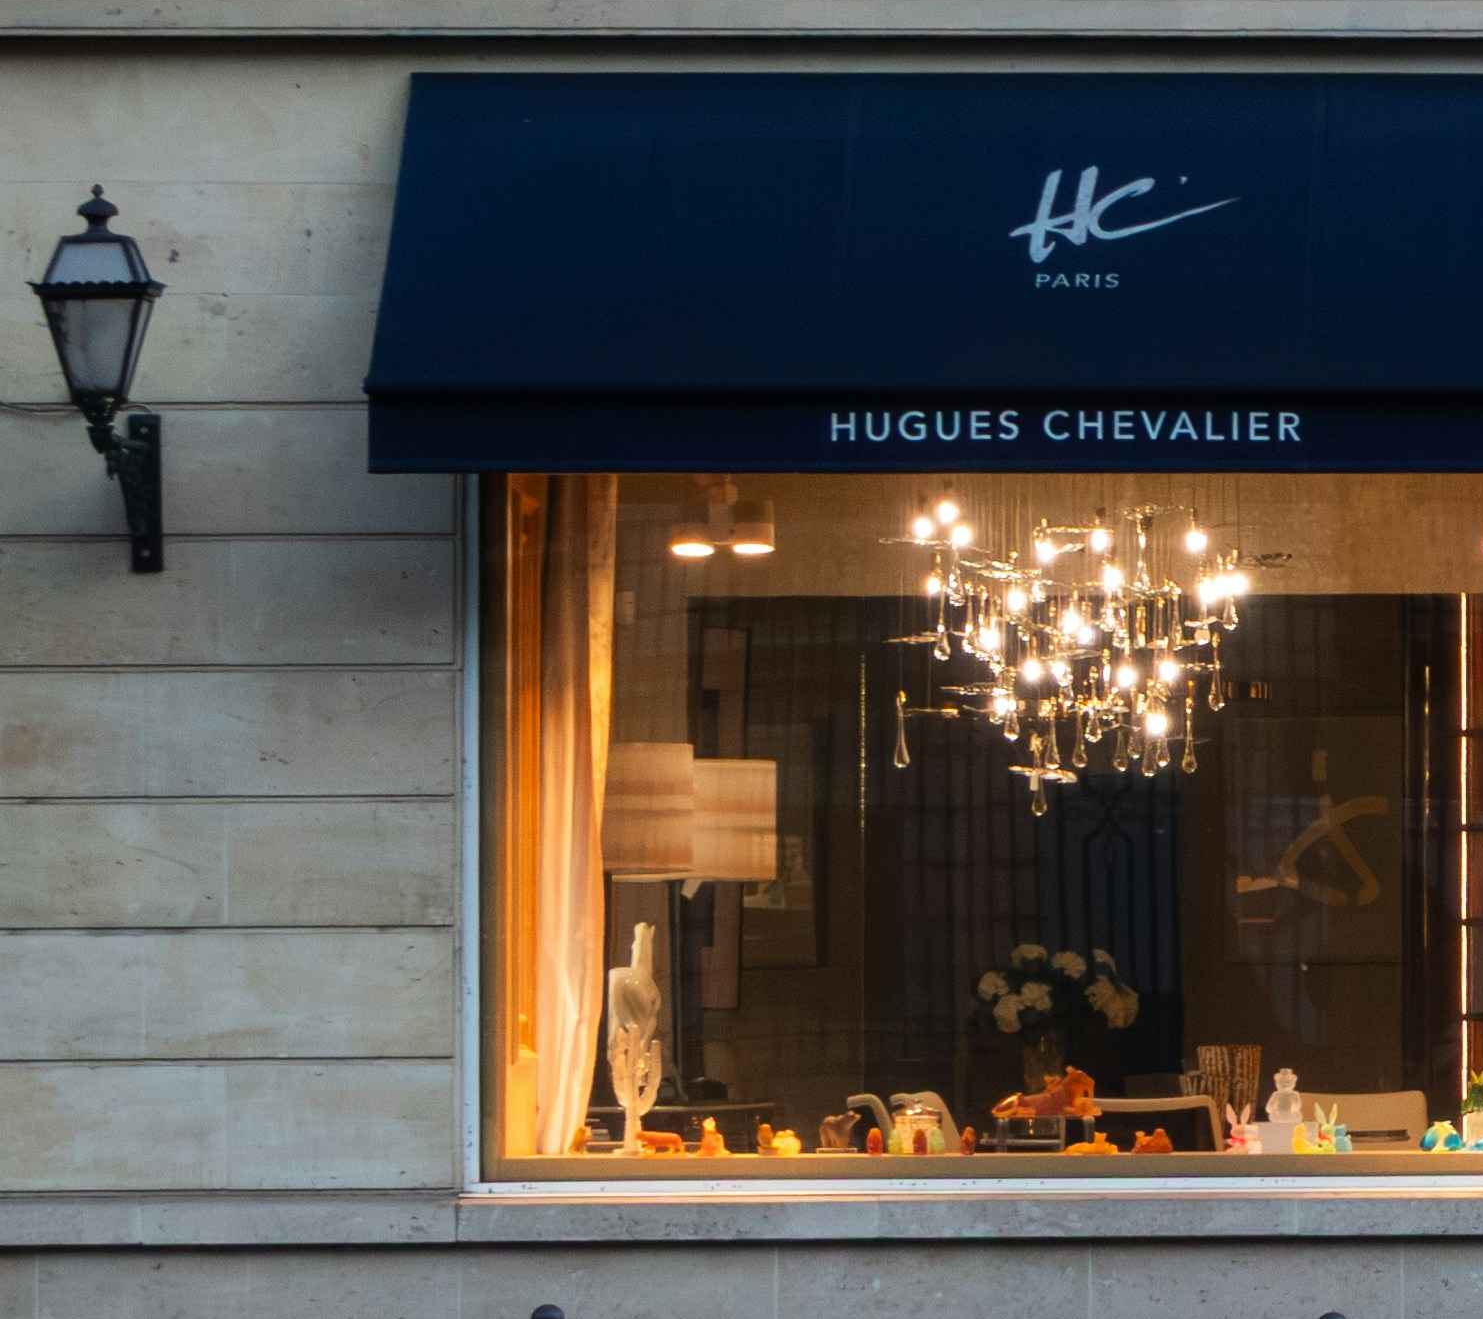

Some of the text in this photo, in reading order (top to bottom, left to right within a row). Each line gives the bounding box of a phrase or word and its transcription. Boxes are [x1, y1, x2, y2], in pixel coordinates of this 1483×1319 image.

[1009, 165, 1243, 264] HC
[1035, 273, 1120, 289] PARIS
[830, 410, 1301, 442] HUGUES CHEVALIER
